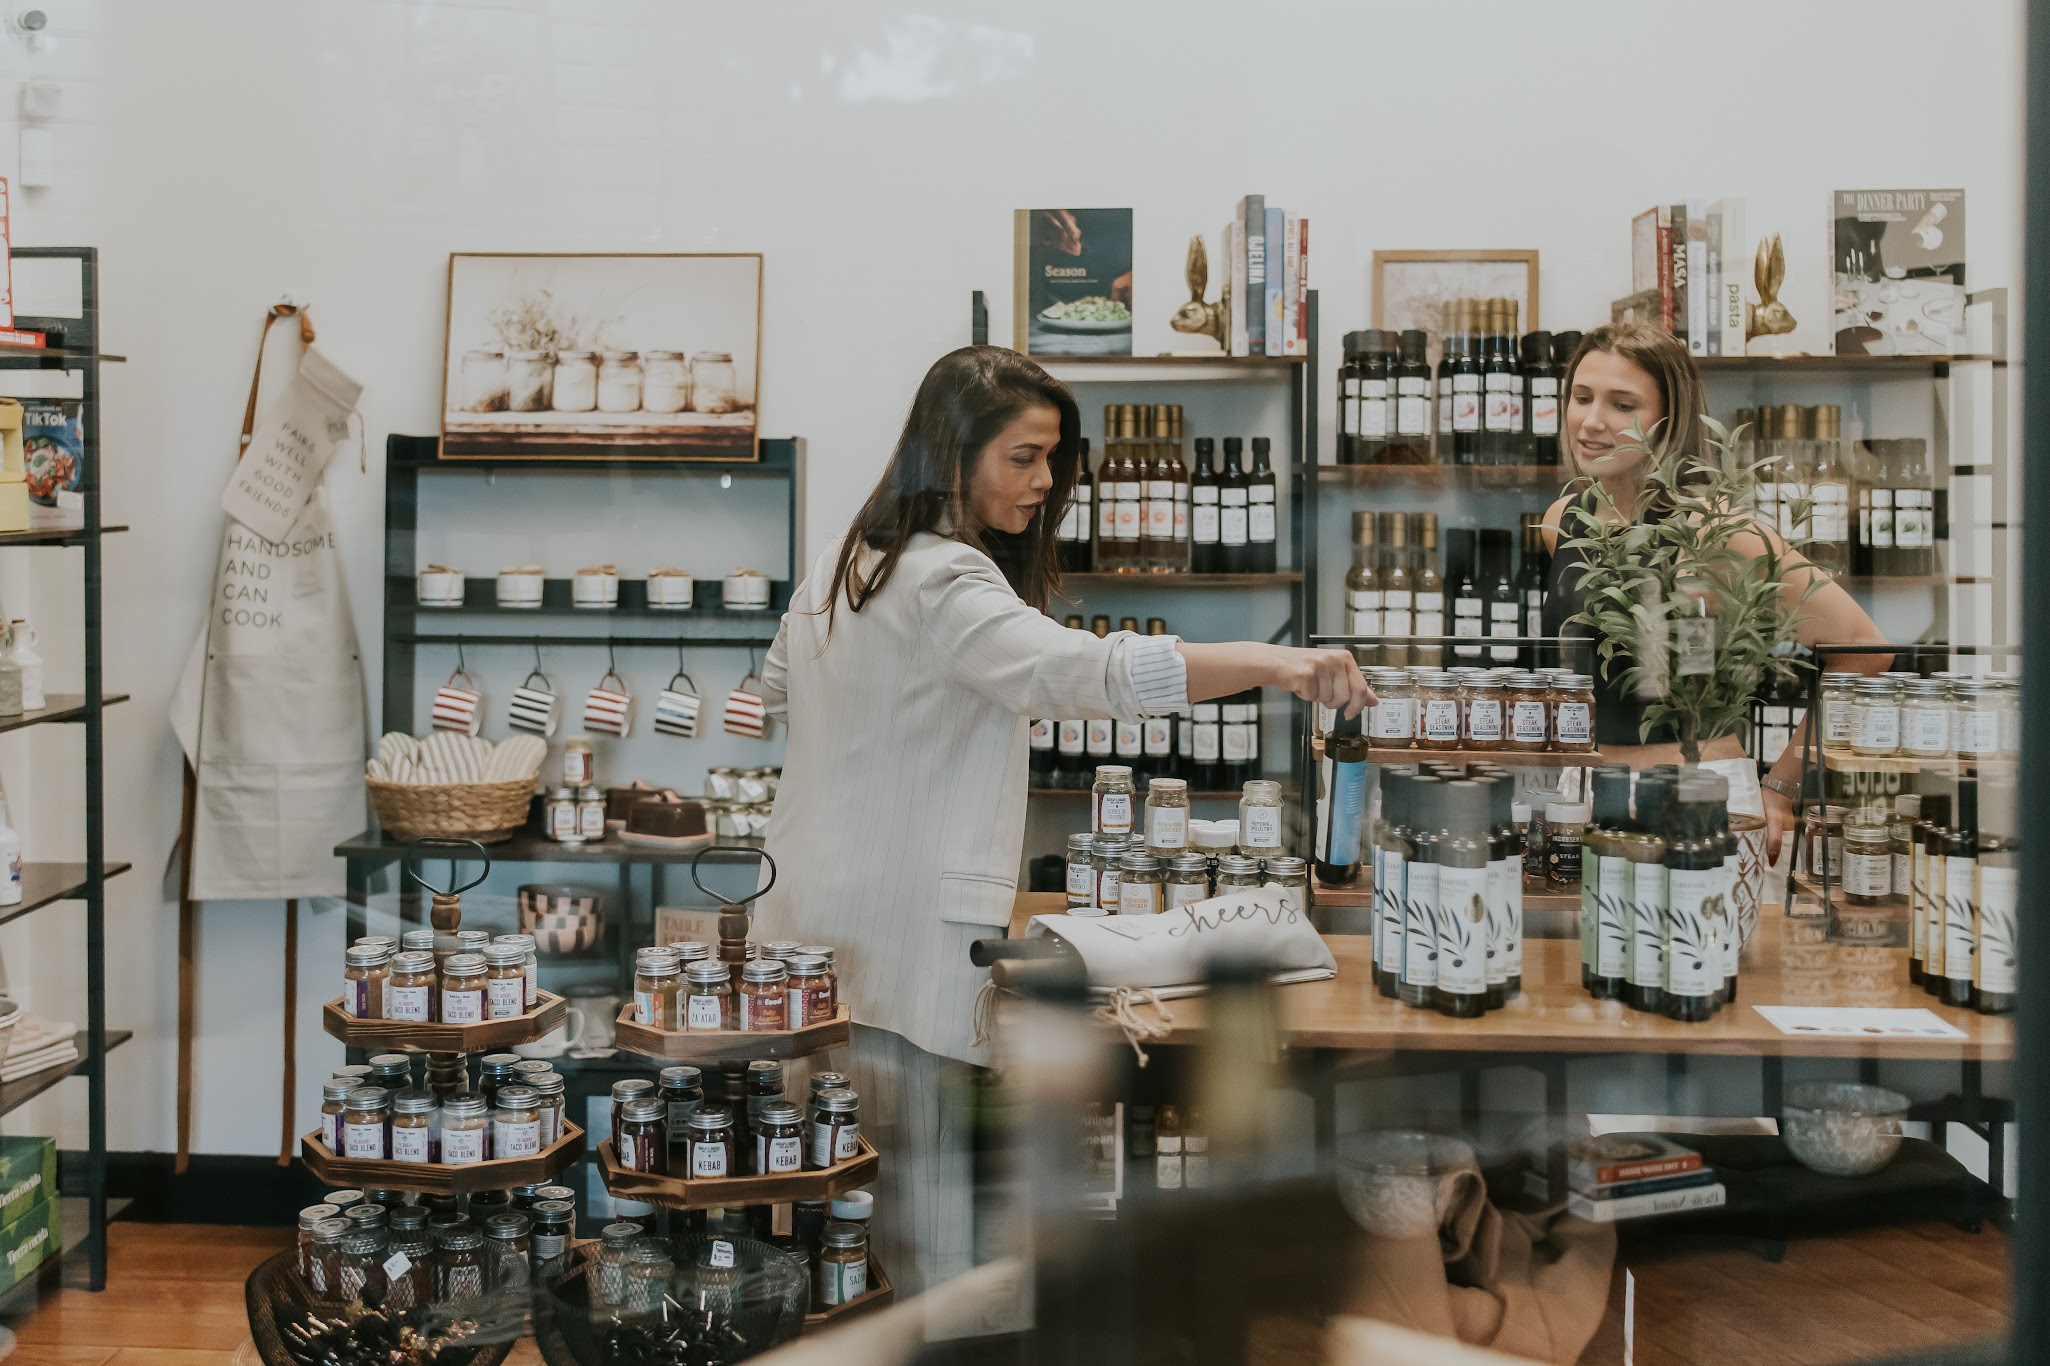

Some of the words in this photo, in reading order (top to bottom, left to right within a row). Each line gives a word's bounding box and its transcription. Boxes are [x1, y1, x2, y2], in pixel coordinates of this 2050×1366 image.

[1857, 192, 1894, 211] DINNER
[1896, 192, 1926, 211] PARTY
[1044, 265, 1087, 277] Season
[1673, 244, 1687, 289] MASA
[1726, 284, 1741, 328] pasta
[24, 412, 67, 427] TikTok
[282, 422, 316, 453] PAIRS
[276, 440, 306, 468] WELL
[265, 453, 303, 483] WITH
[254, 469, 293, 498] GOOD
[240, 480, 291, 518] FRIENDS
[228, 532, 336, 558] HANDSOME
[226, 560, 271, 580] AND
[224, 583, 268, 603] CAN
[662, 916, 705, 934] TABLE
[1168, 899, 1299, 937] cheers
[394, 1006, 404, 1014] TACO
[406, 1006, 421, 1014] BLEND
[489, 998, 500, 1006] TACO
[459, 1011, 475, 1019] BLEND
[361, 1144, 376, 1152] BLEND
[448, 1150, 459, 1158] TACO
[461, 1150, 476, 1158] BLEND
[510, 1143, 522, 1151] TACO
[524, 1141, 537, 1150] BLEND
[698, 1160, 721, 1171] KEBAB
[776, 1155, 797, 1167] KEBAB
